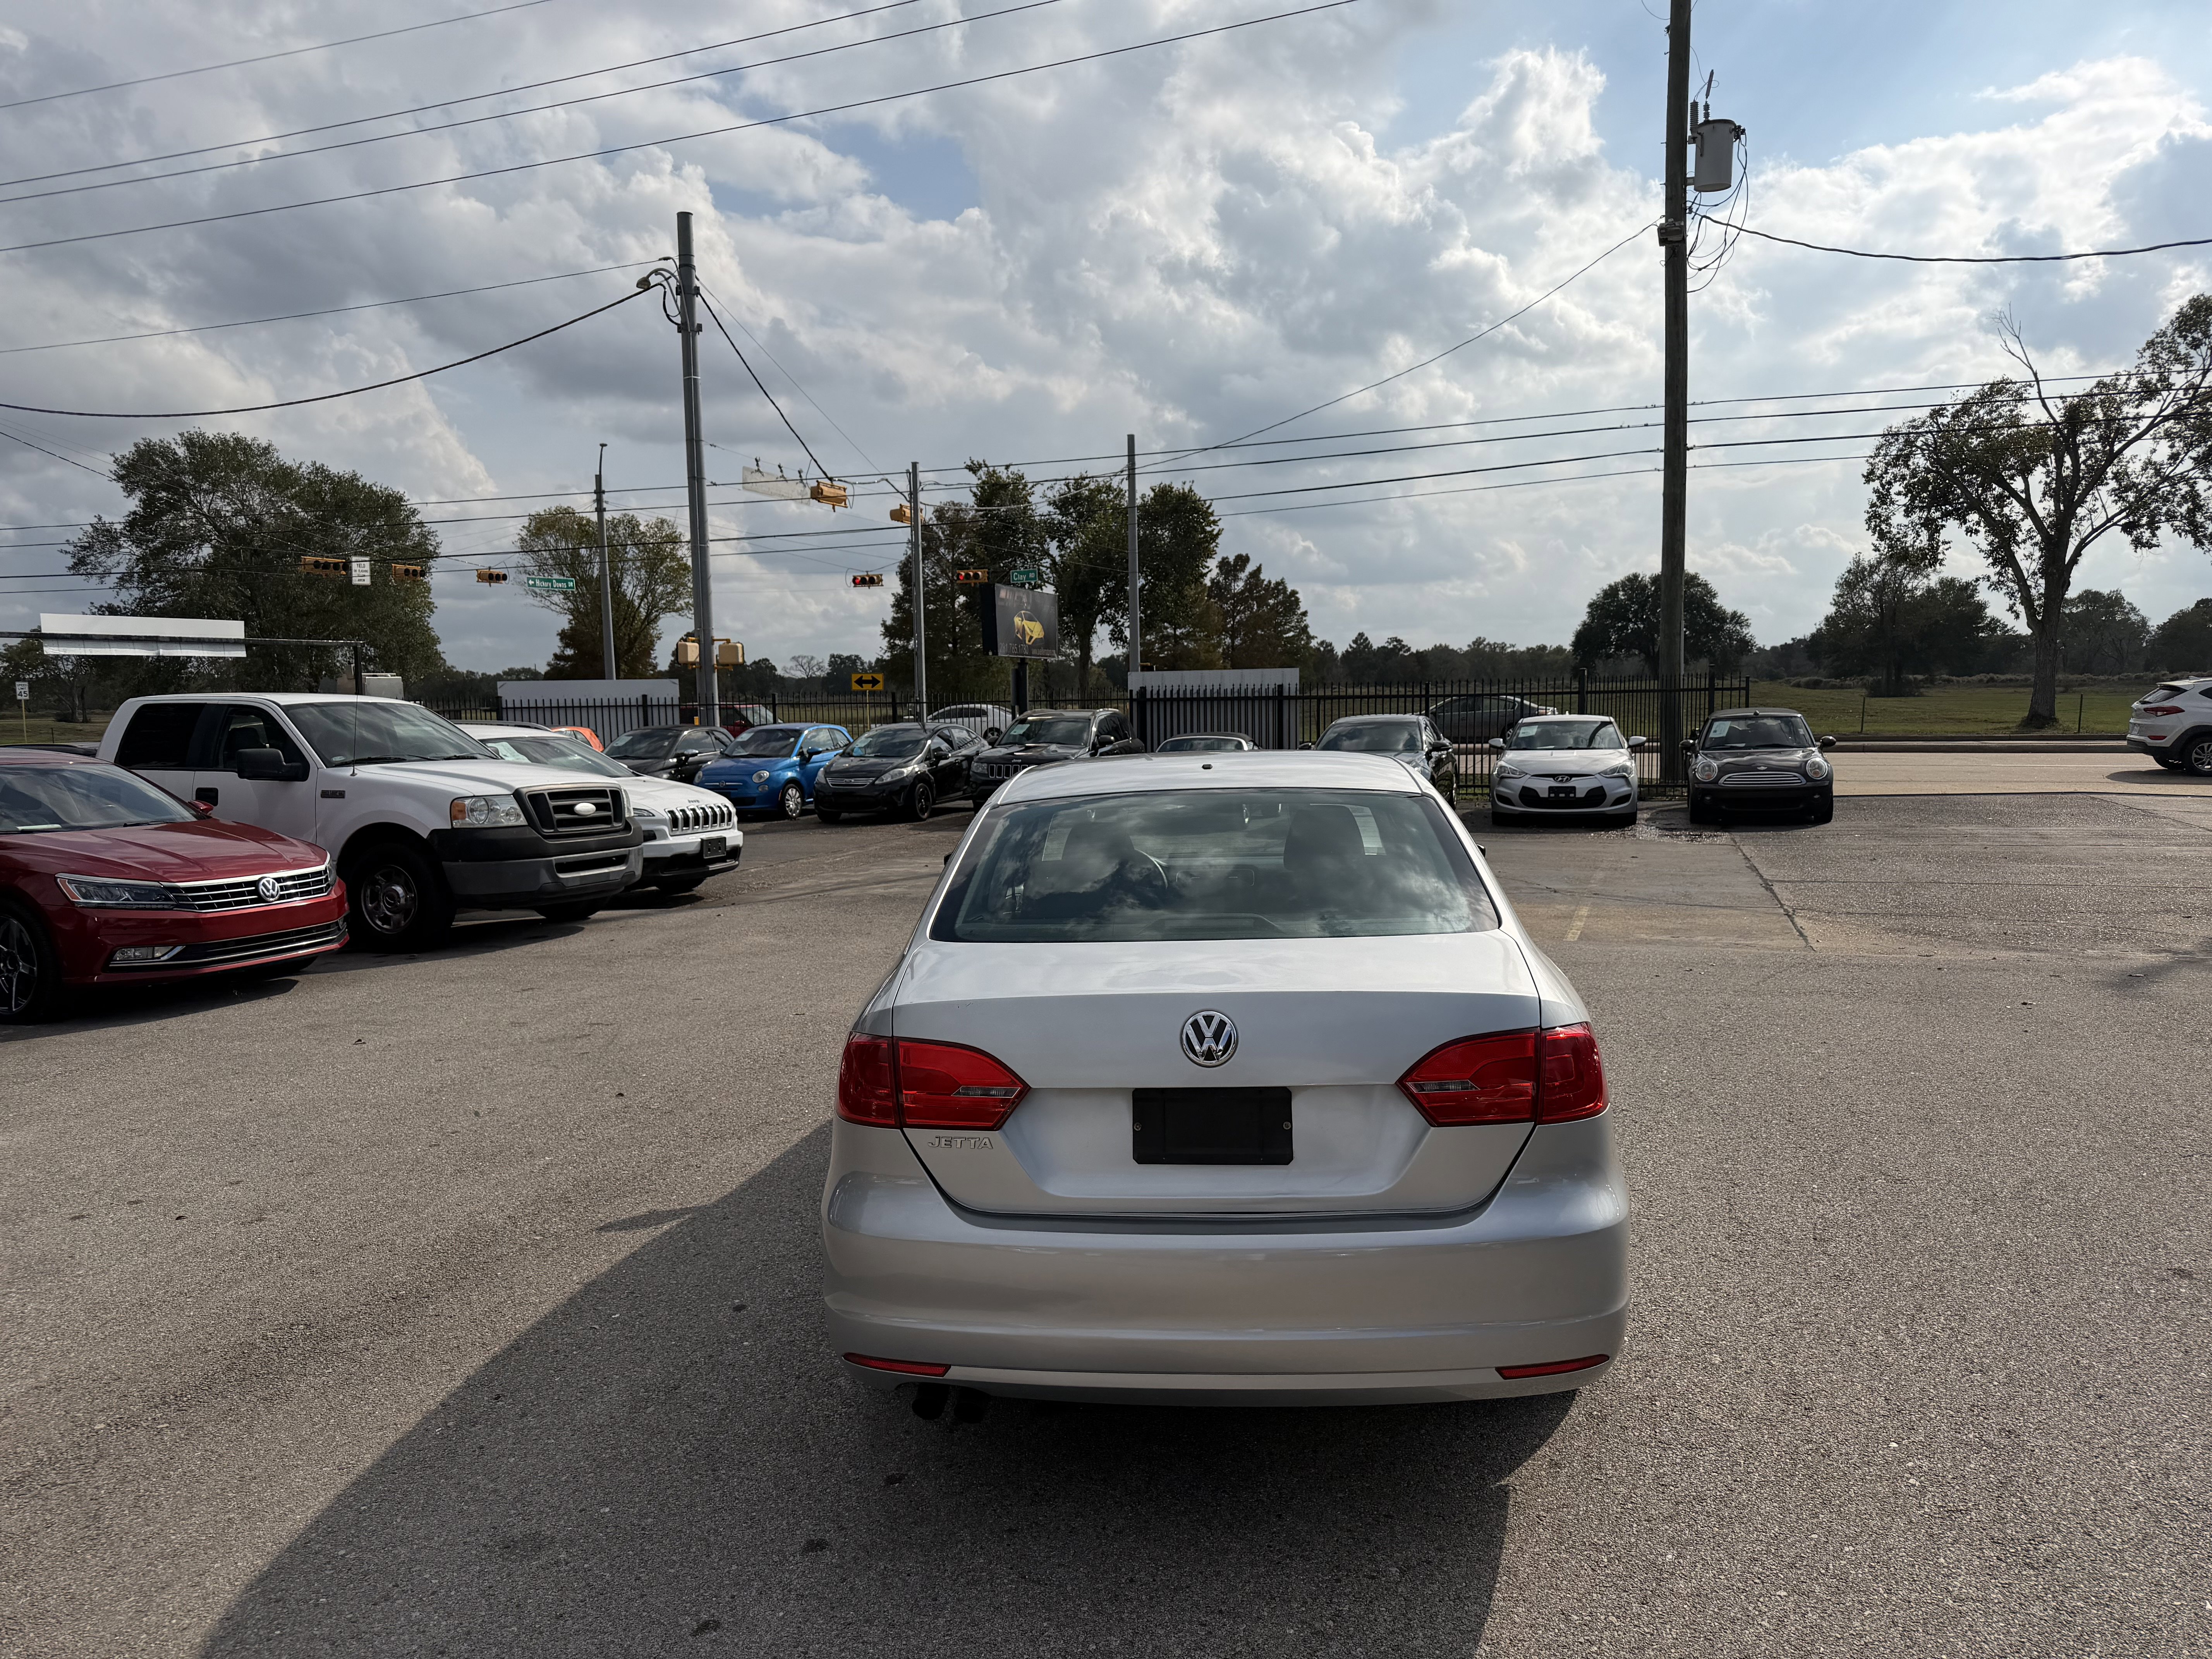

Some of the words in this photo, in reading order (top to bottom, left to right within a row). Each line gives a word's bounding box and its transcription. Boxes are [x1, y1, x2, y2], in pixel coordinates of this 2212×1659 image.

[536, 579, 551, 588] Hickory
[553, 579, 567, 588] Downs
[1013, 572, 1026, 582] Clay
[259, 878, 279, 901] VW
[1183, 1012, 1235, 1065] VW
[928, 1136, 993, 1149] JETTA
